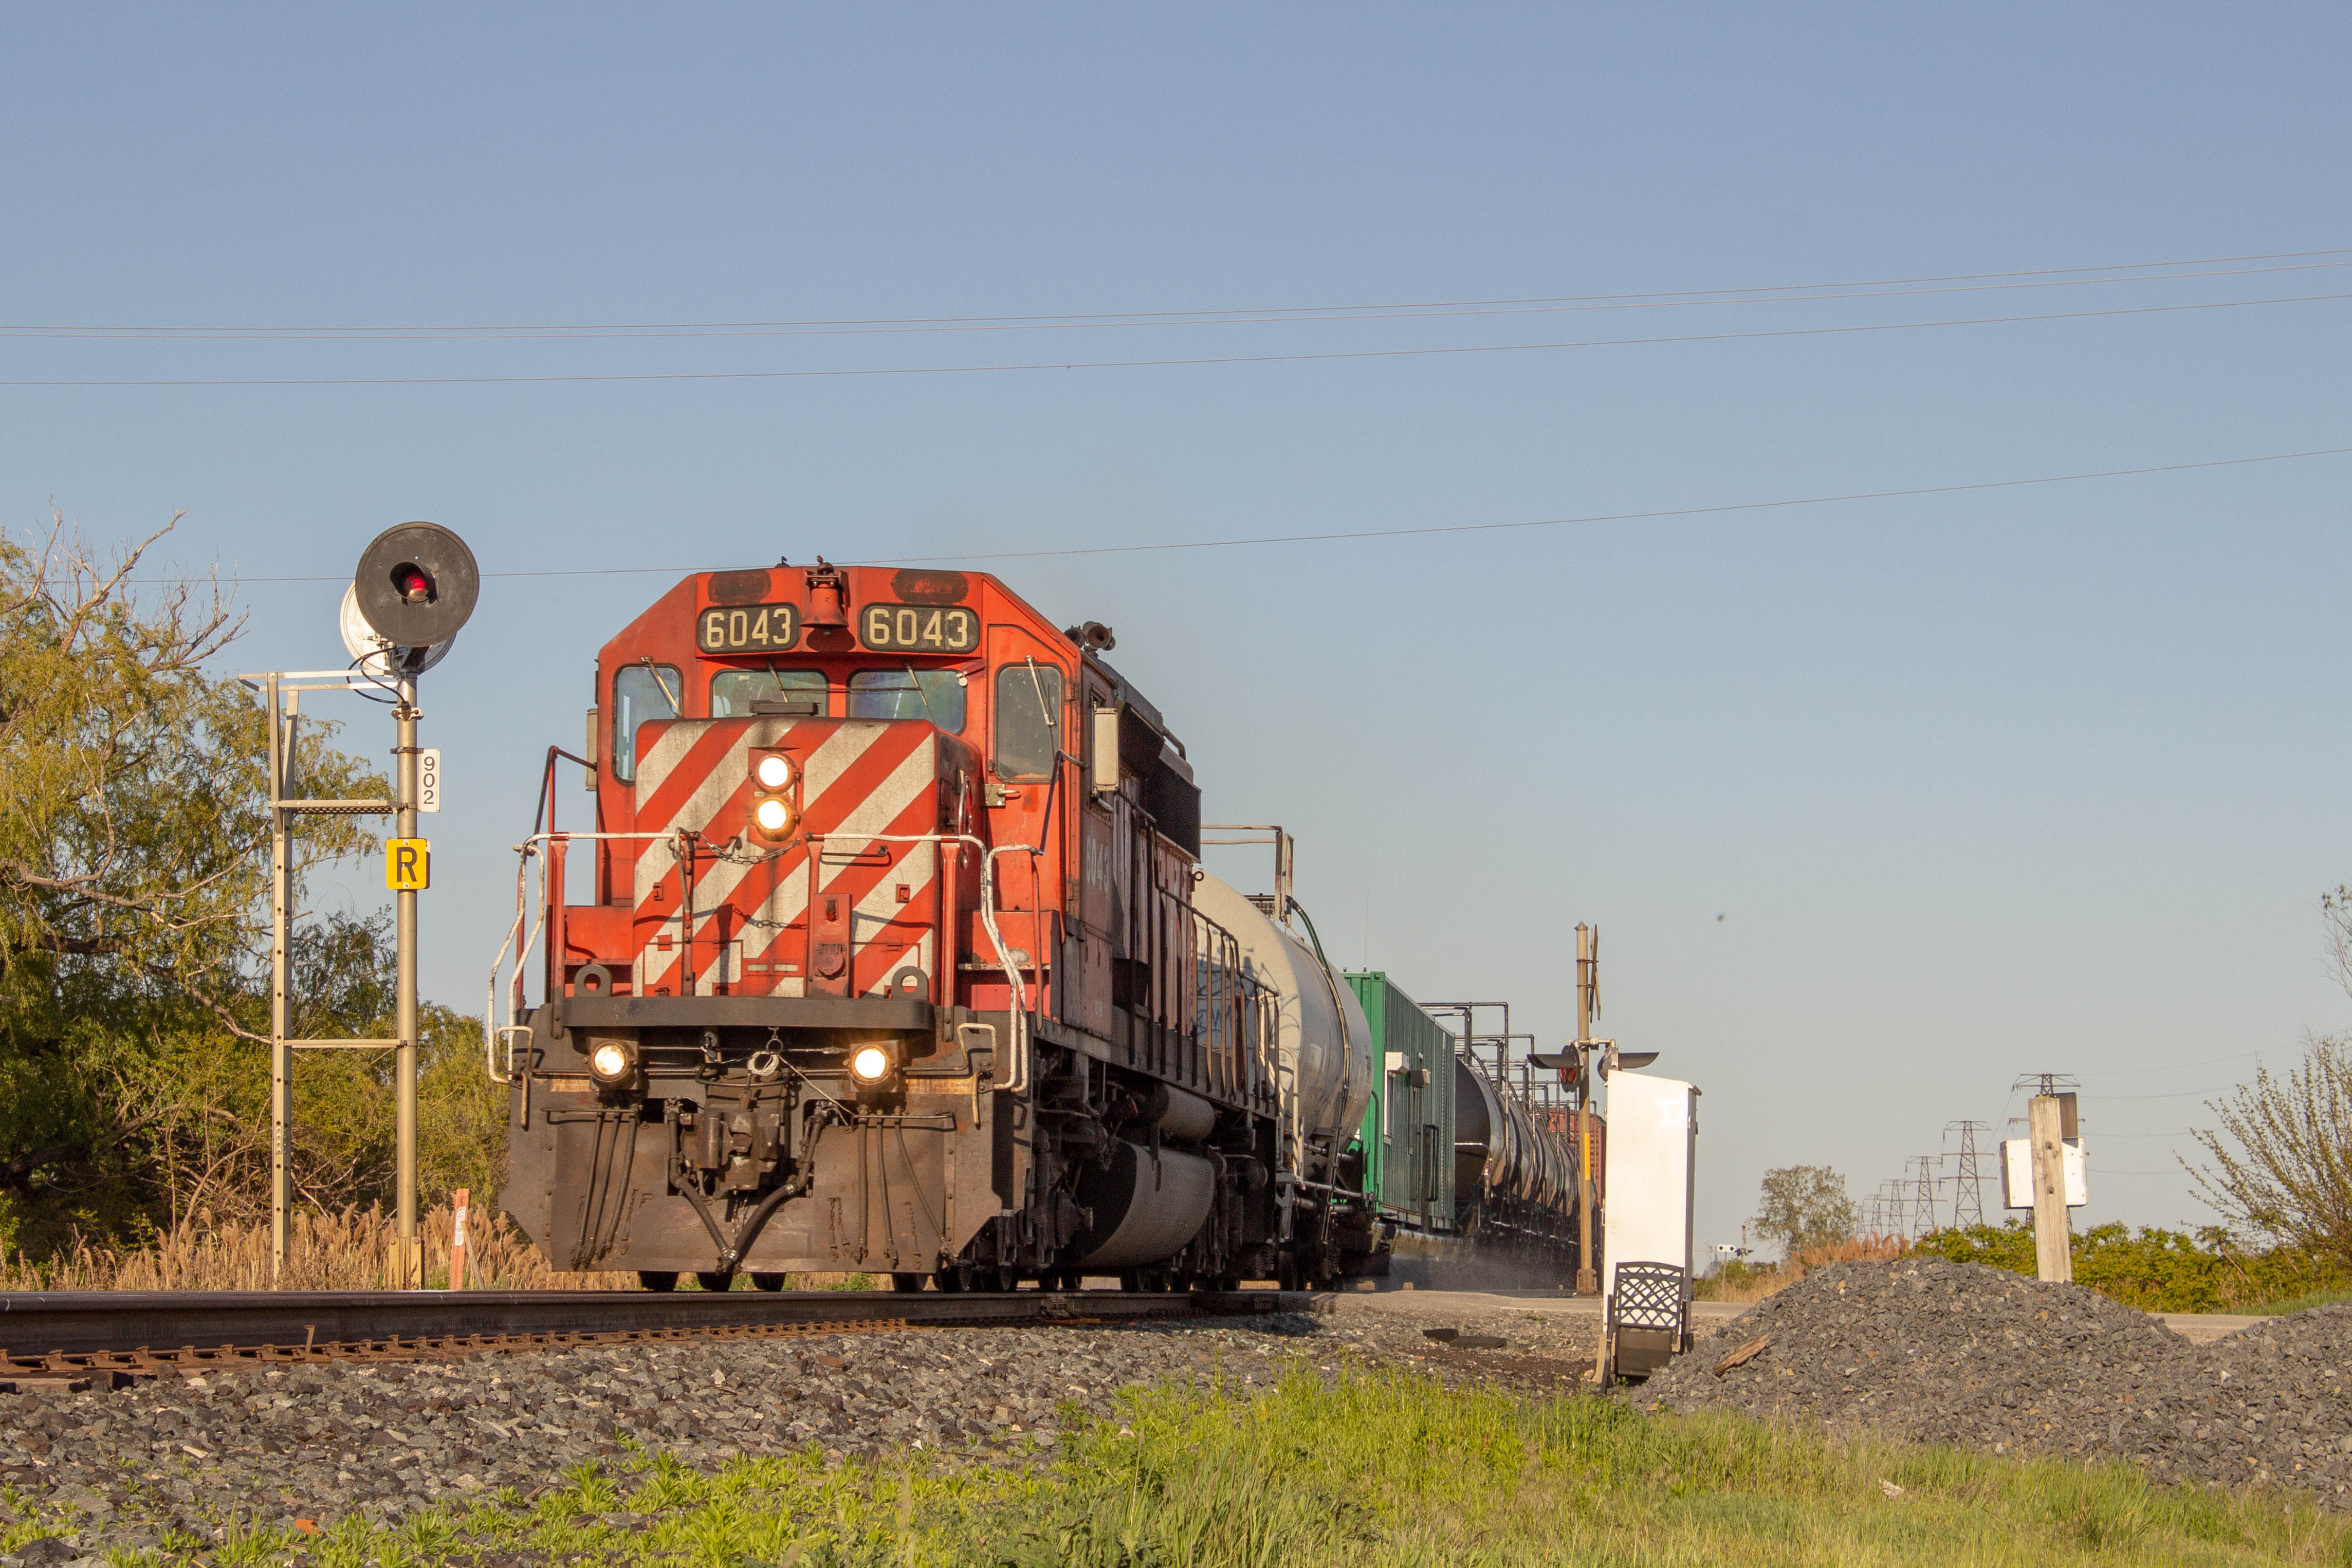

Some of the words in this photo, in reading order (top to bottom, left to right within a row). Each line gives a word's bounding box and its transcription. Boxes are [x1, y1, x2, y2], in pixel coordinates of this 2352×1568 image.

[707, 608, 792, 648] 6043
[869, 608, 967, 647] 6043
[423, 756, 435, 804] 902
[396, 846, 417, 882] R
[1086, 834, 1110, 894] 6043
